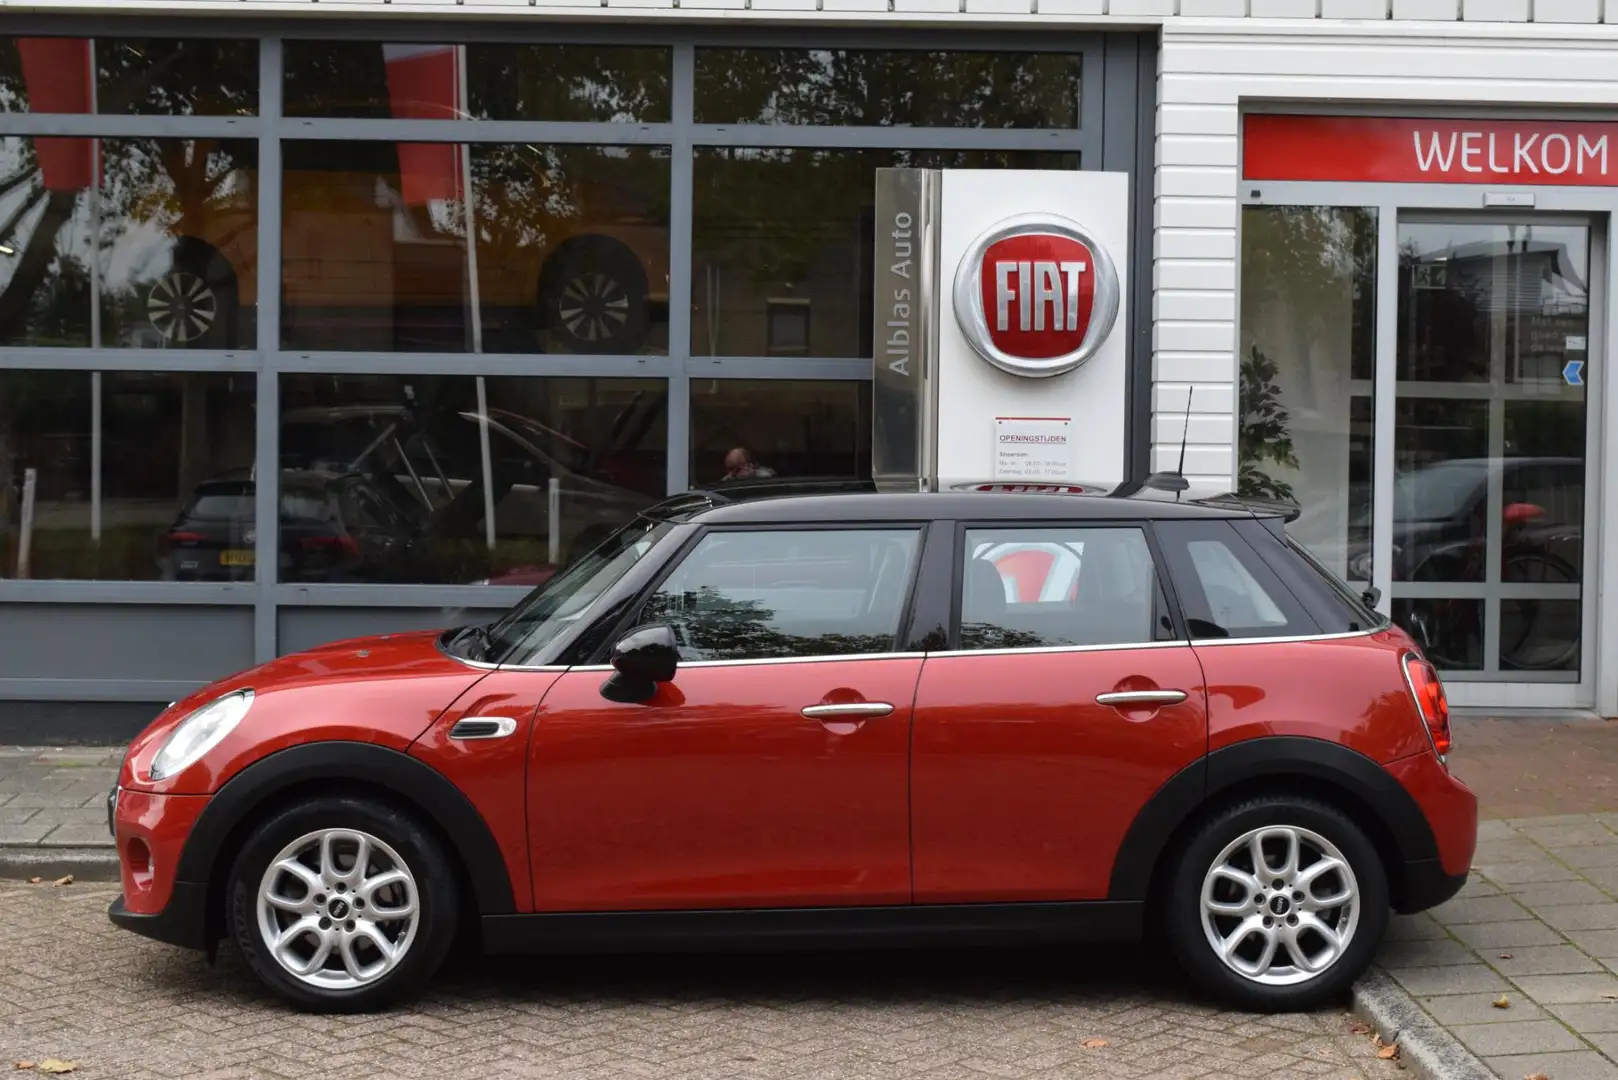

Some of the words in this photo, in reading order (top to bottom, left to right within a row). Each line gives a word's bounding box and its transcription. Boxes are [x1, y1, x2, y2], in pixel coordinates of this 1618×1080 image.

[1413, 131, 1608, 175] WELKOM
[890, 212, 913, 279] Auto
[995, 260, 1087, 332] FIAT
[886, 288, 912, 376] Alblas
[999, 434, 1067, 442] OPENINGSTIJDEN
